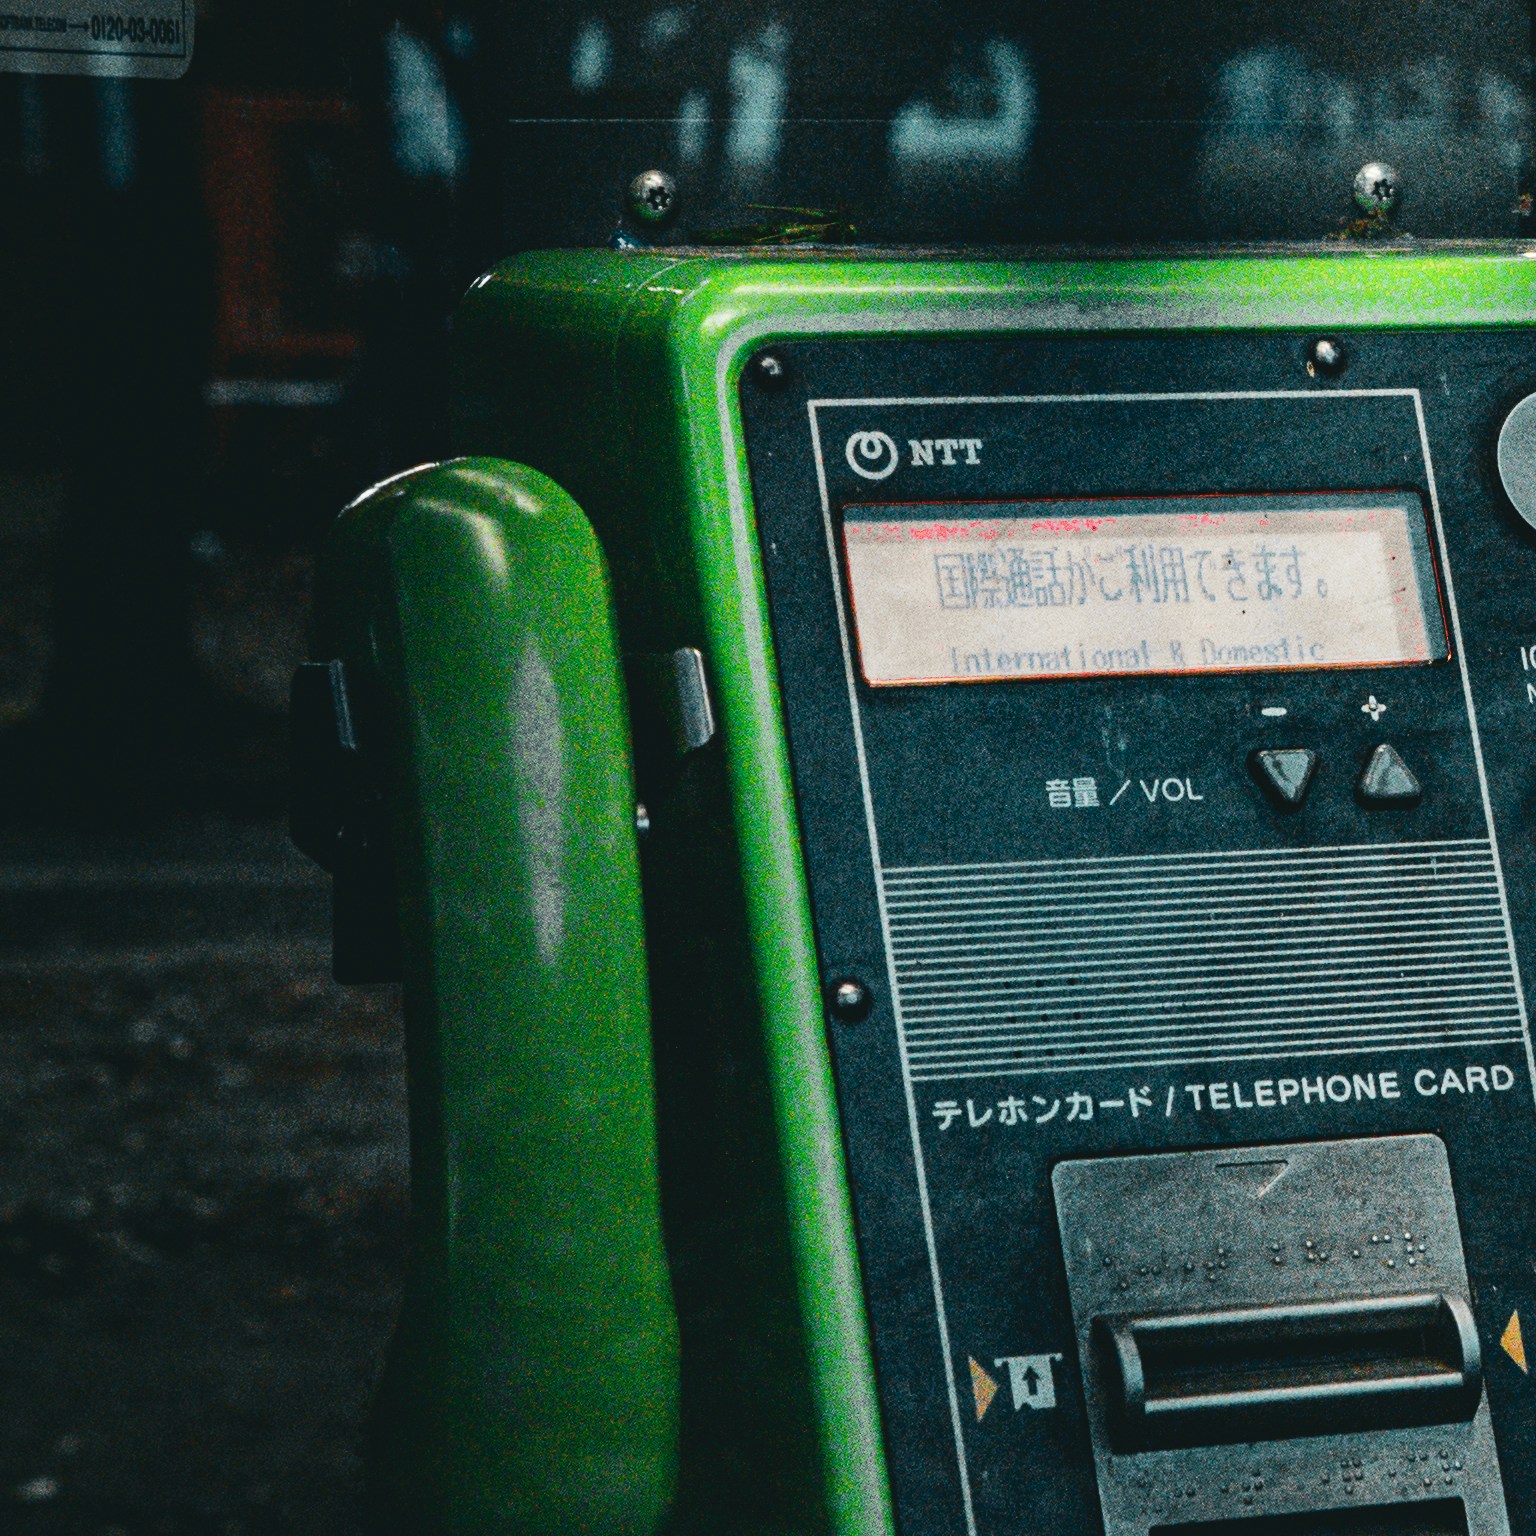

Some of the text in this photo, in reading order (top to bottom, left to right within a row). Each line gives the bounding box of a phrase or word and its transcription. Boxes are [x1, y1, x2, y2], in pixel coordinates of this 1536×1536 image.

[90, 15, 180, 45] 0120-03-0061
[909, 439, 982, 466] NTT
[932, 542, 1329, 611] 国際通話がご利用できます。
[951, 638, 1150, 673] International
[1201, 635, 1326, 667] Domestic
[1045, 777, 1099, 808] 音量
[1139, 776, 1203, 804] VOL
[932, 1088, 1152, 1130] テレホンカード
[1185, 1071, 1401, 1111] TELEPHONE
[1415, 1065, 1514, 1097] CARD
